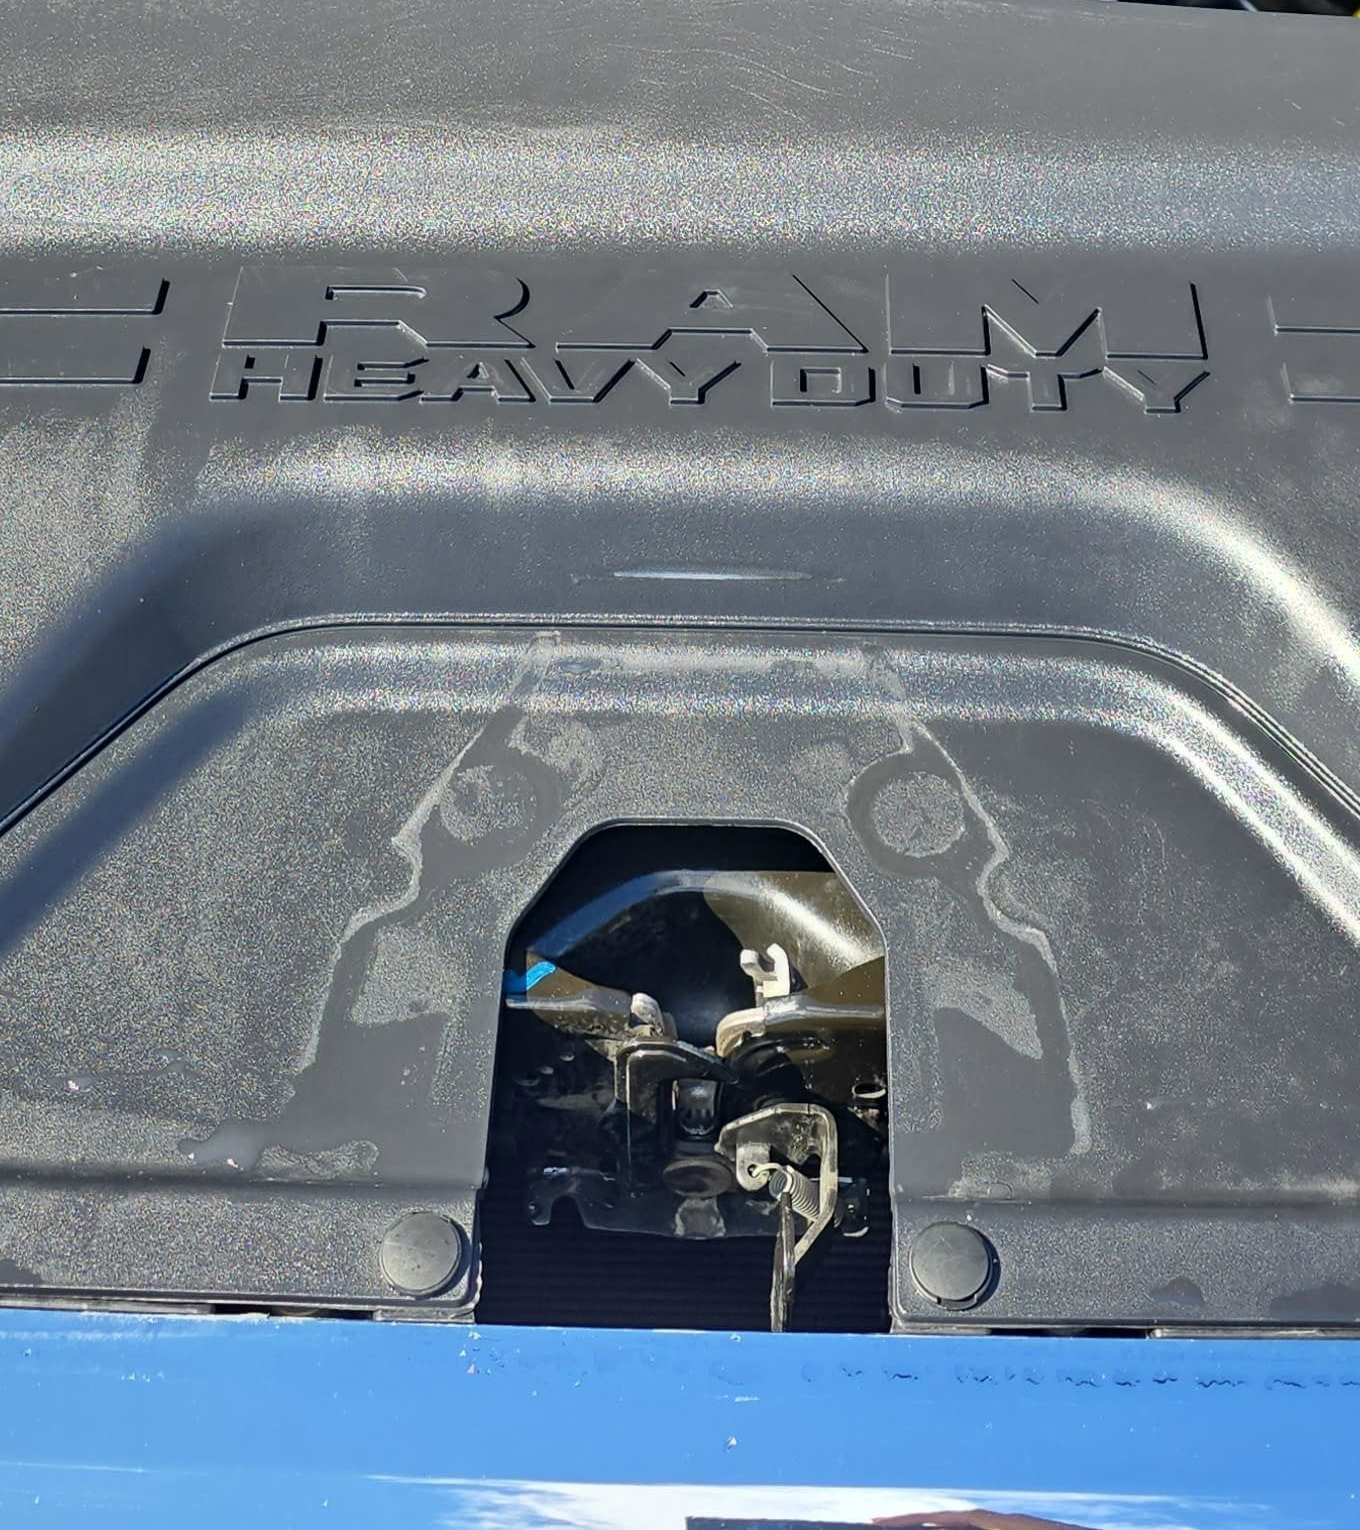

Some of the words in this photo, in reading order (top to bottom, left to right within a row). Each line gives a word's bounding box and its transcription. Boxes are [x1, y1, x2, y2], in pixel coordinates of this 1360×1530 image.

[222, 267, 1209, 359] RAM
[208, 354, 741, 405] HEAVY
[770, 362, 1211, 413] DUTY
